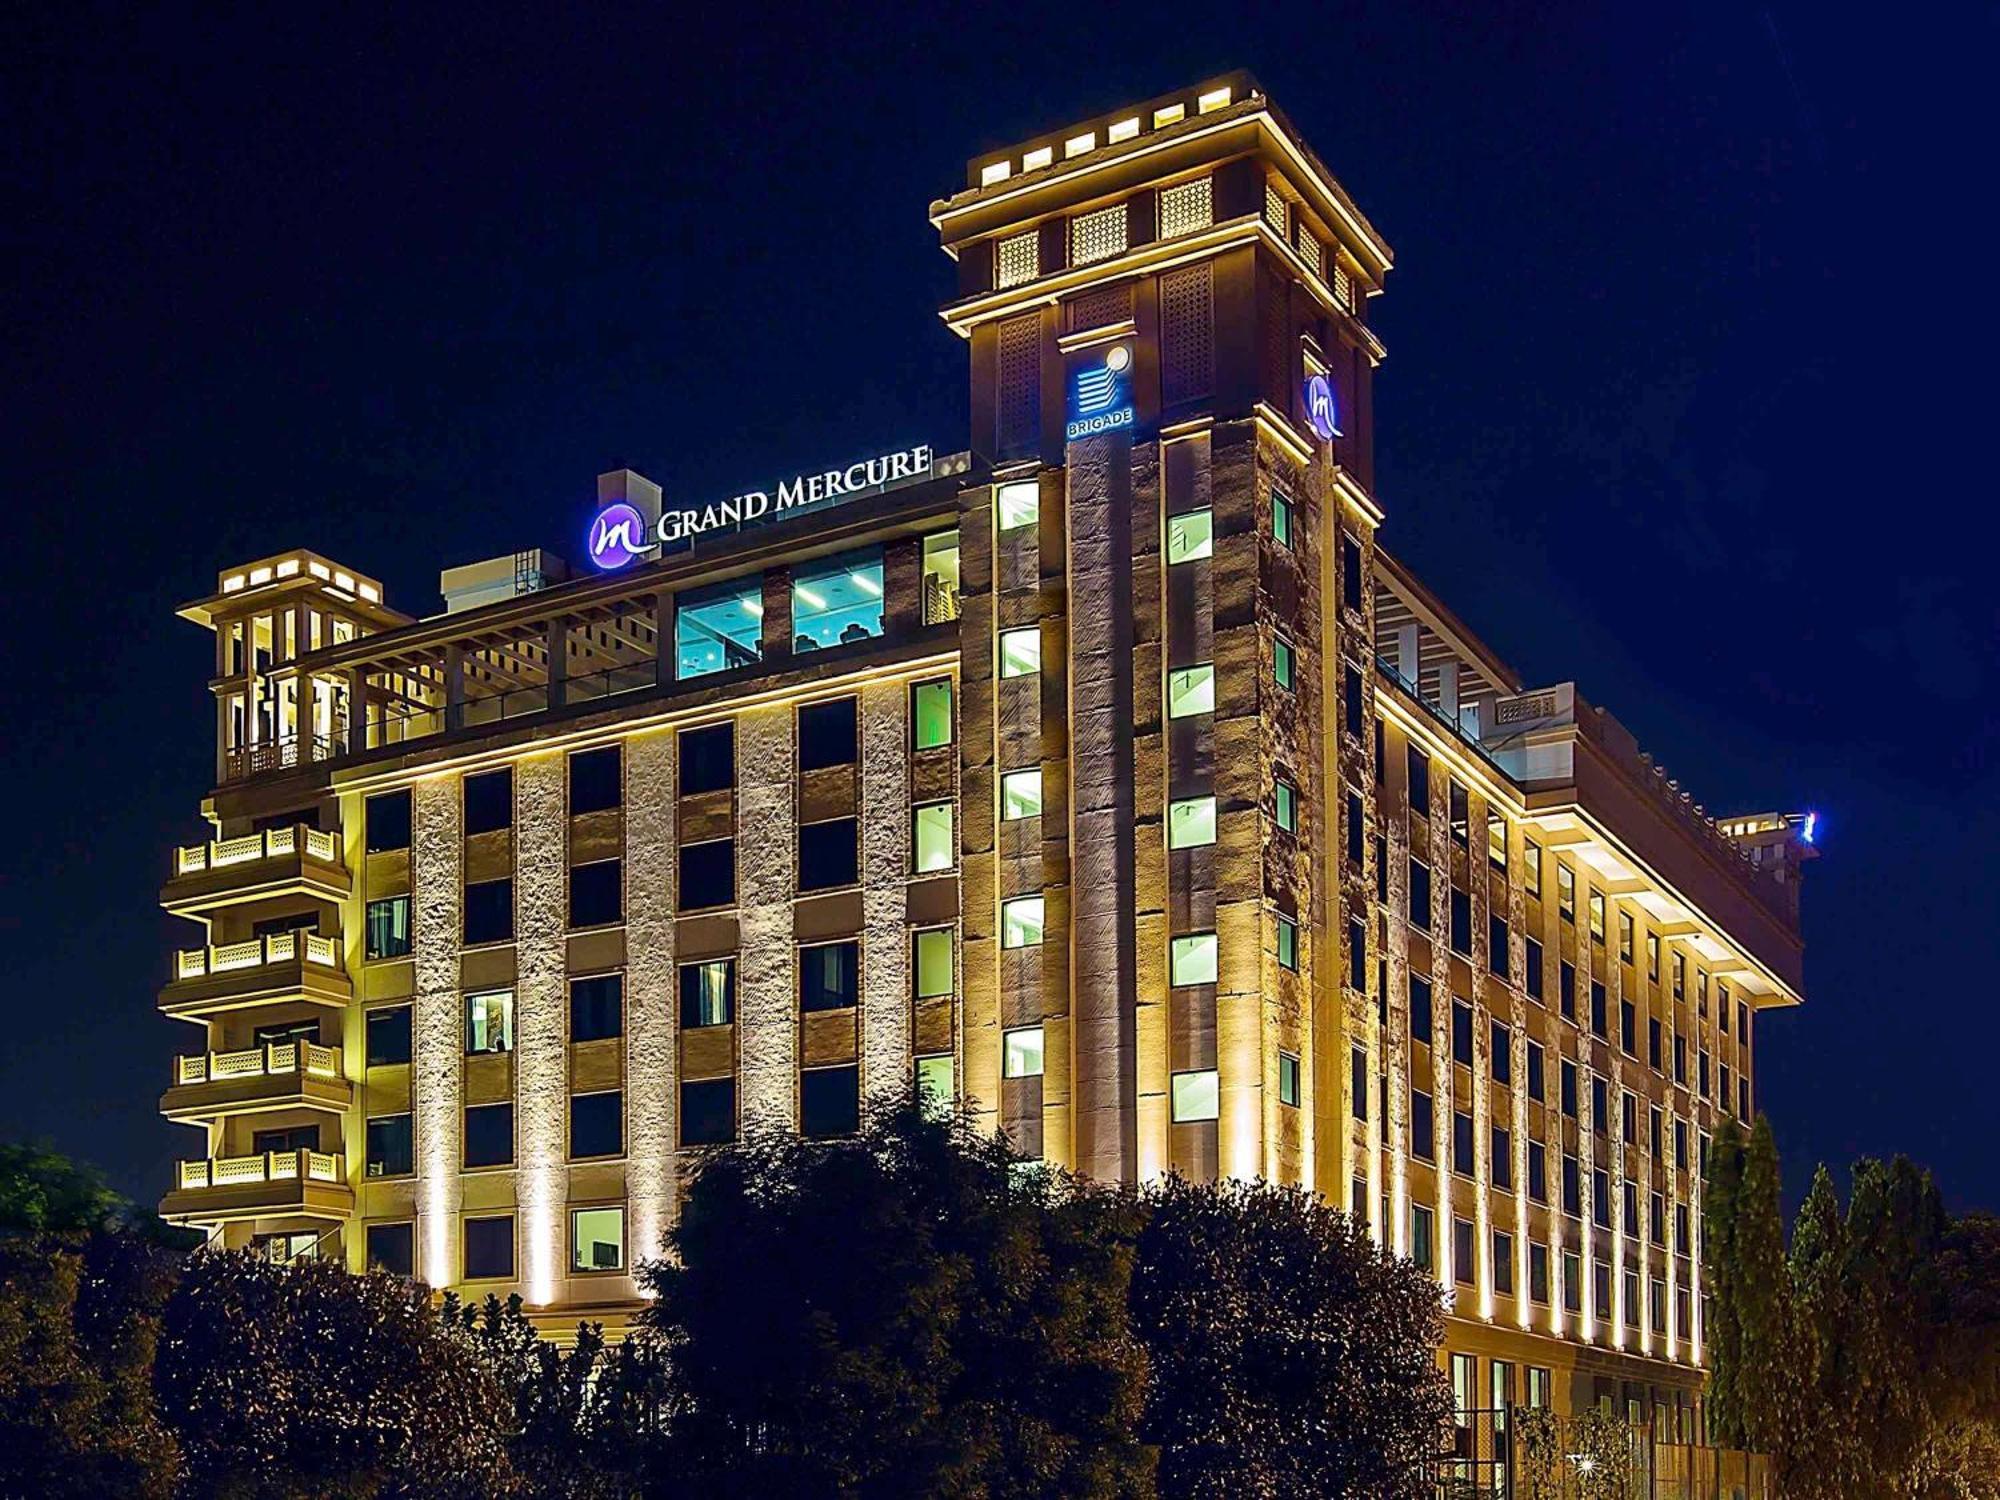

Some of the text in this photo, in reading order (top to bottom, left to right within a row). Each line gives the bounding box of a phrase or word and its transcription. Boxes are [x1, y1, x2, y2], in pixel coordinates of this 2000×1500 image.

[1067, 408, 1132, 437] BRIGADE
[657, 445, 930, 541] GRAND MERCURE
